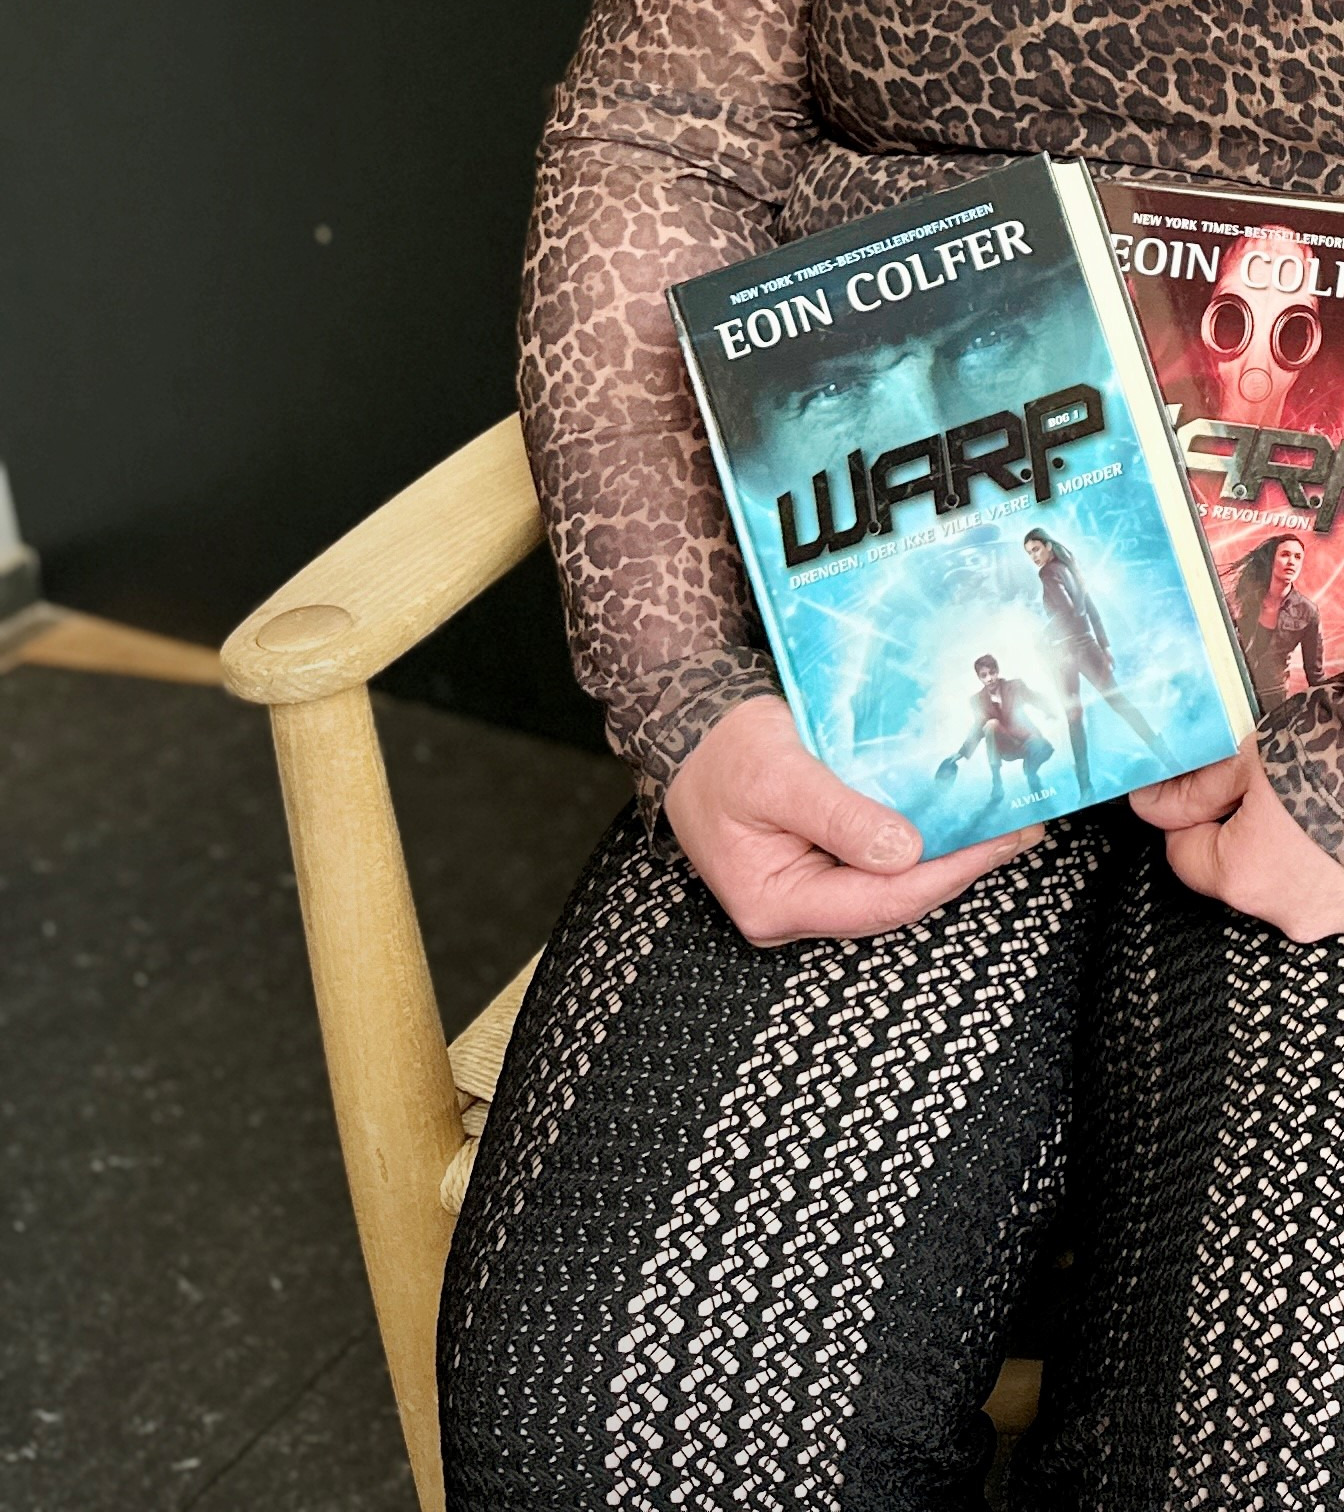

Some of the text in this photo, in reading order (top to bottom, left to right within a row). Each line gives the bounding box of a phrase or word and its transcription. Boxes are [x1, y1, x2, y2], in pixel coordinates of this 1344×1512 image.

[1132, 212, 1162, 227] NEW
[1164, 215, 1198, 232] YORK
[1111, 233, 1221, 283] EOIN
[713, 219, 1034, 361] EOIN COLFER
[730, 286, 759, 306] NEW
[760, 273, 794, 295] YORK
[1047, 412, 1070, 428] BOG
[788, 462, 1124, 590] DRENGEN, DER IKKE VILLE VÆRE MORDER
[1211, 506, 1310, 530] REVOLUTION
[1010, 786, 1058, 809] ALVILDA
